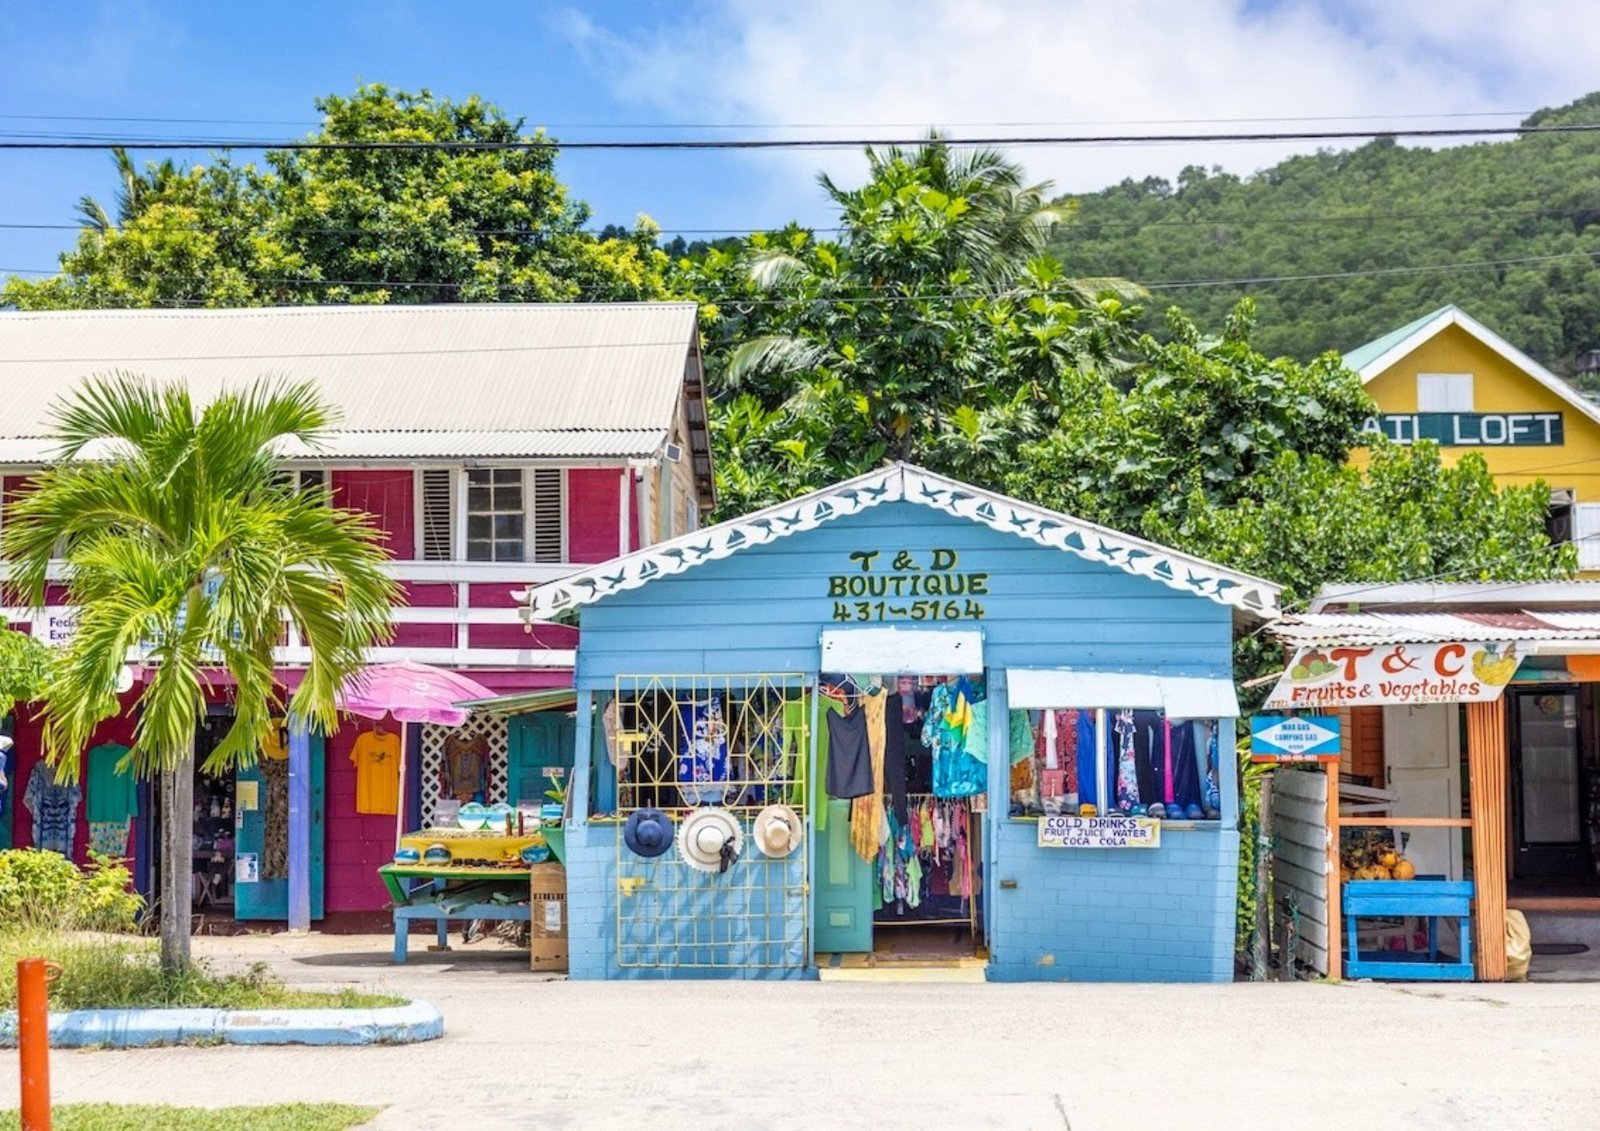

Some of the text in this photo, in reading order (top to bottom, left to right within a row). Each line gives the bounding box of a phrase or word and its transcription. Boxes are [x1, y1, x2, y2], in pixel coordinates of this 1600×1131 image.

[1361, 414, 1560, 444] AIL LOFT
[849, 548, 958, 572] T & D
[827, 573, 990, 597] BOUTIQUE
[1330, 643, 1467, 681] T & C
[1291, 678, 1480, 703] Fruits & Vegetables
[1044, 828, 1147, 838] FRUIT JUICE WATER
[1047, 818, 1138, 829] COLD DRINKS
[1062, 837, 1127, 846] COCA COLA
